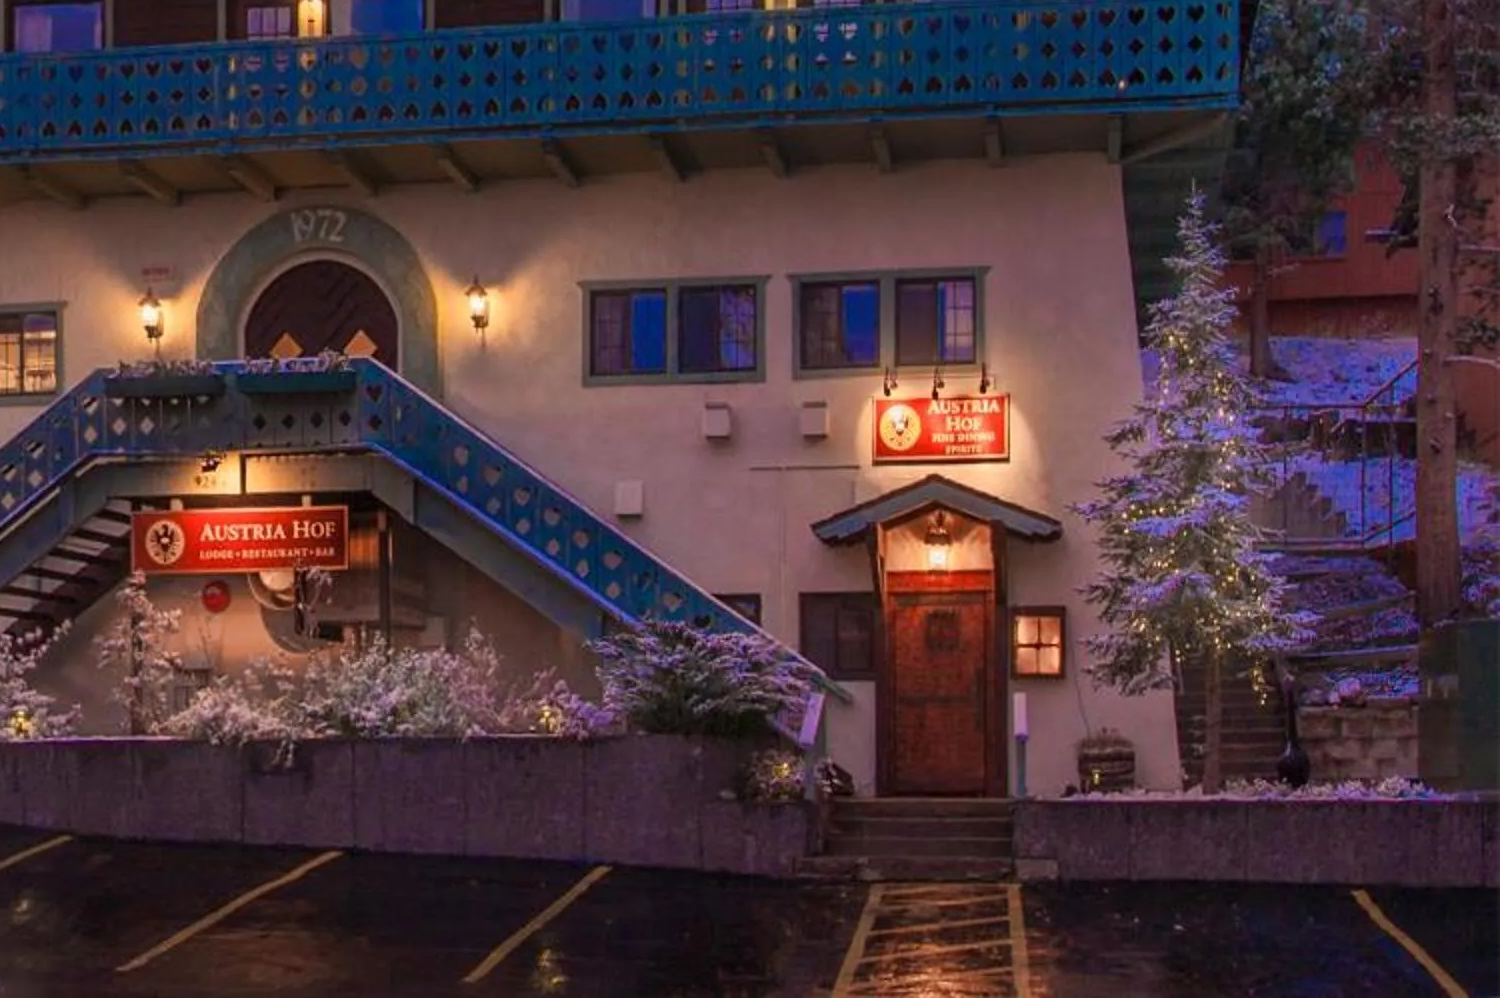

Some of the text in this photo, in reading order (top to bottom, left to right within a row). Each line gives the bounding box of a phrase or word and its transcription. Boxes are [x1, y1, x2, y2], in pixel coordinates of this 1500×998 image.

[290, 209, 346, 242] 1972
[928, 399, 1000, 414] AUSTRIA
[946, 416, 983, 431] HOF
[200, 520, 336, 542] AUSTRIA HOF
[200, 549, 234, 560] LODGE
[242, 547, 308, 559] RESTAURANT
